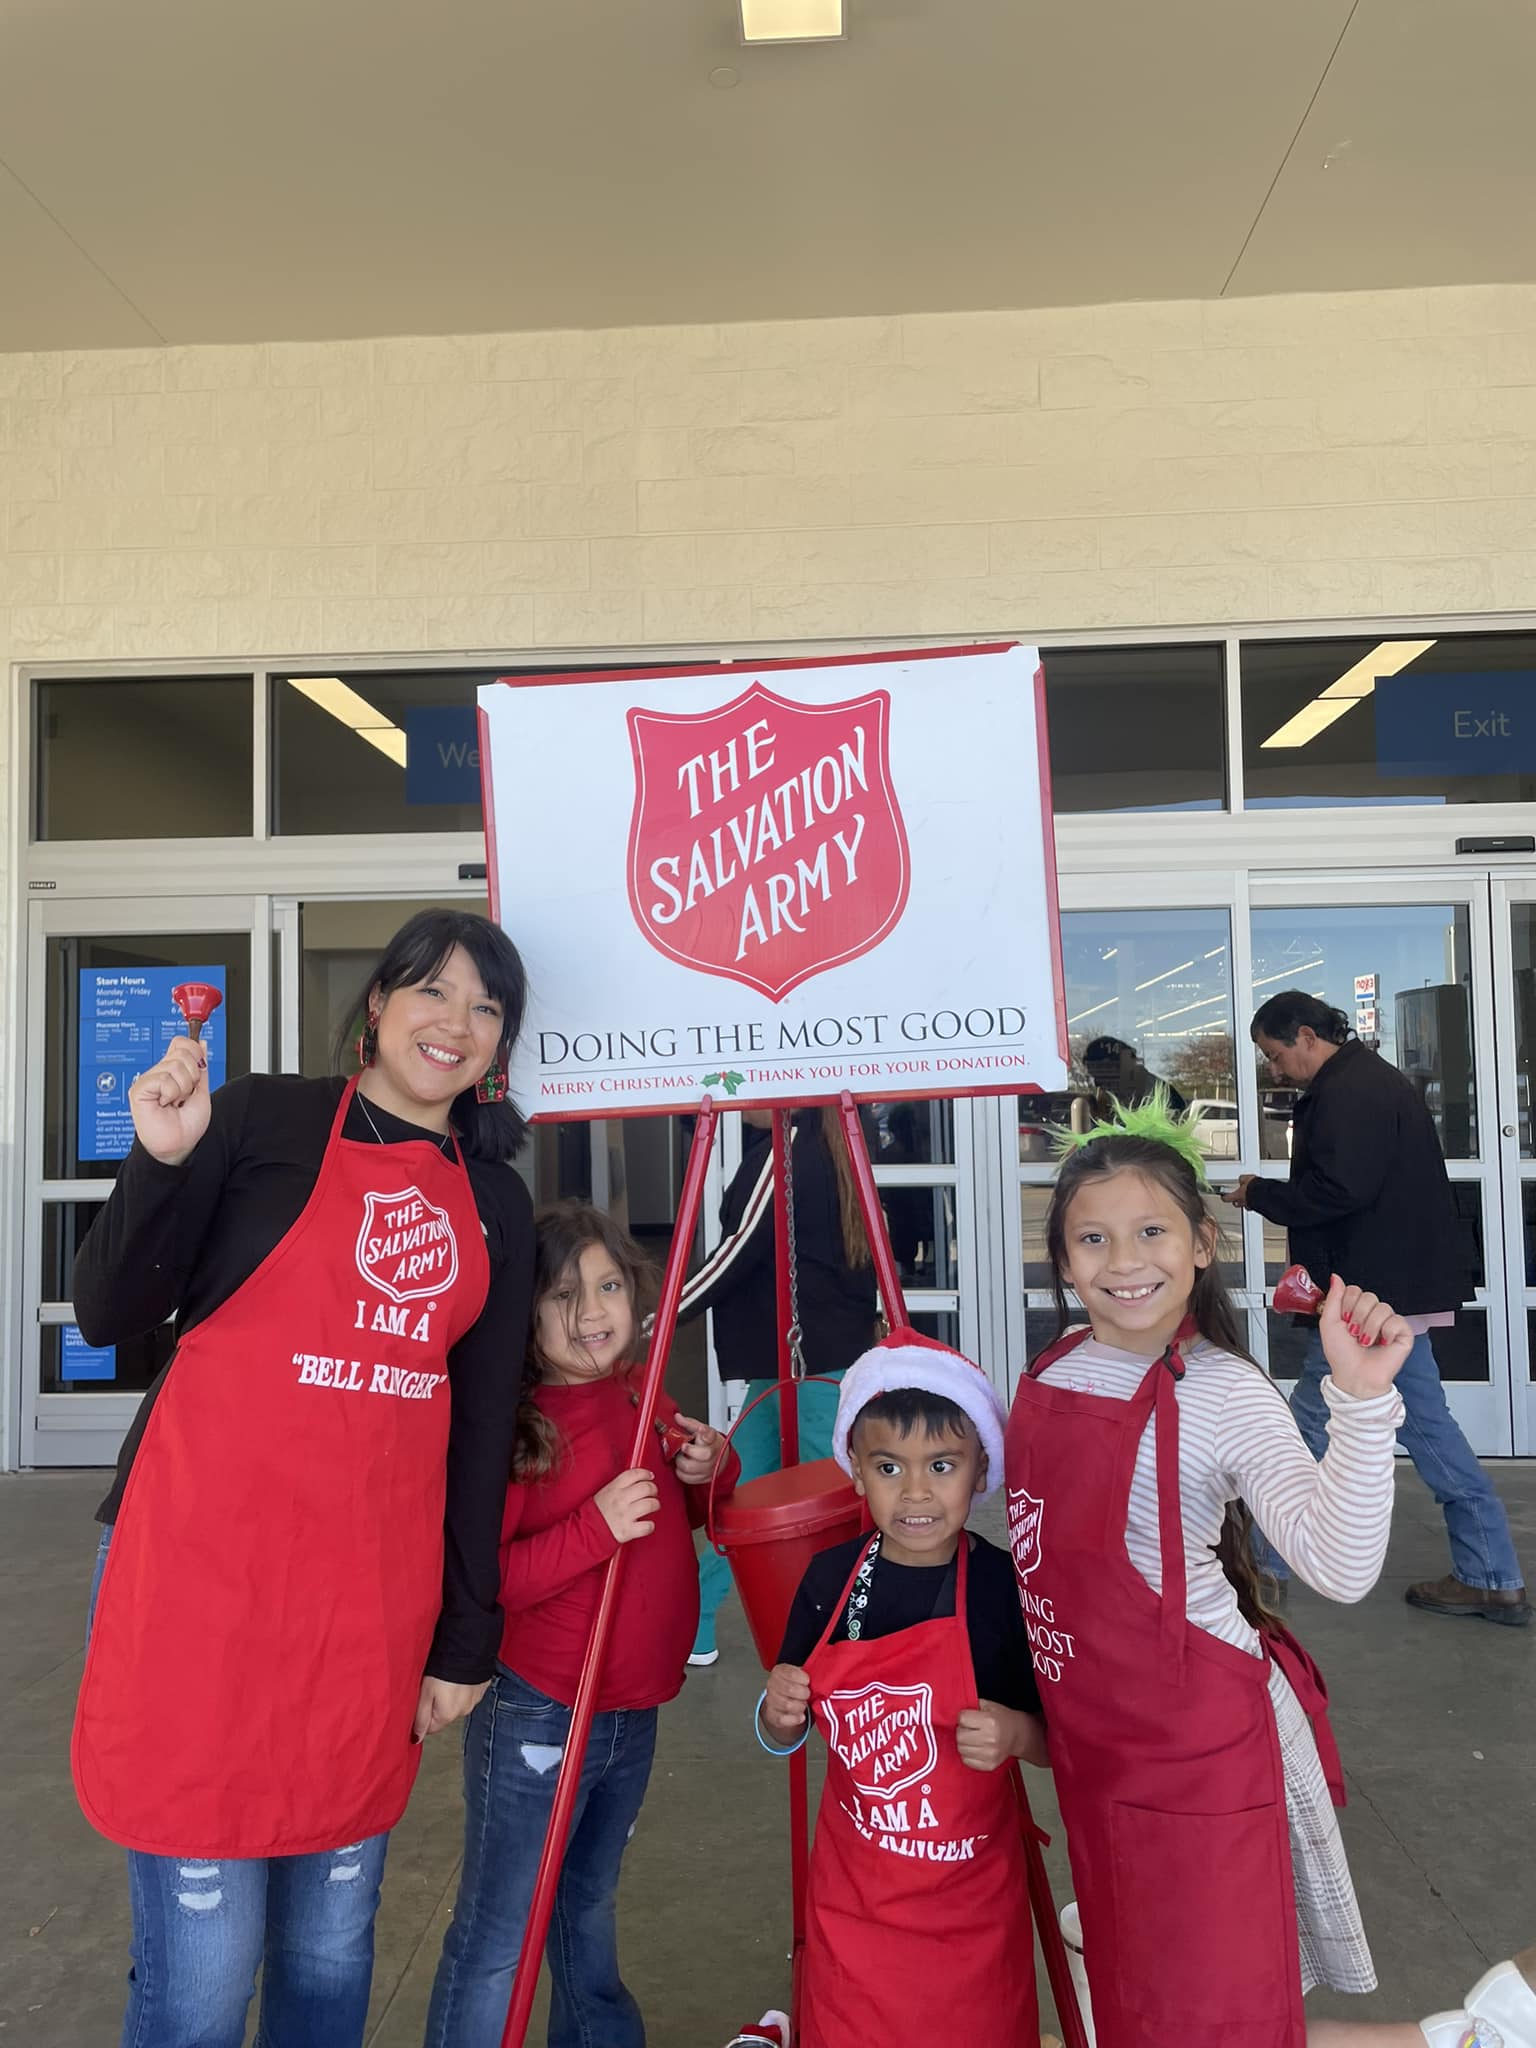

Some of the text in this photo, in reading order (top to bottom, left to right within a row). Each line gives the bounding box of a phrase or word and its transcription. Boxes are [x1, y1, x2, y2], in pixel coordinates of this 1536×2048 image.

[1454, 709, 1512, 737] Exit
[437, 741, 480, 768] We
[678, 718, 776, 819] THE
[650, 726, 869, 924] SALVATION
[735, 813, 865, 962] ARMY
[96, 975, 146, 986] Store Hours
[96, 988, 125, 997] Monday
[130, 987, 152, 997] Friday
[96, 998, 127, 1007] Saturday
[96, 1007, 122, 1016] Sunday
[537, 1006, 1027, 1065] DOING THE MOST GOOD
[541, 1054, 1030, 1096] MERRY CHRISTMAS. THANK YOU FOR YOUR DONATION.
[384, 1200, 424, 1229] THE
[365, 1217, 448, 1264] SALVATION
[392, 1242, 448, 1283] ARMY
[354, 1300, 430, 1342] I AM A
[291, 1353, 364, 1391] "BELL
[837, 1699, 921, 1770] SALVATION
[845, 1693, 885, 1735] THE
[874, 1726, 918, 1784] ARMY
[870, 1801, 911, 1832] AM
[917, 1798, 939, 1829] A
